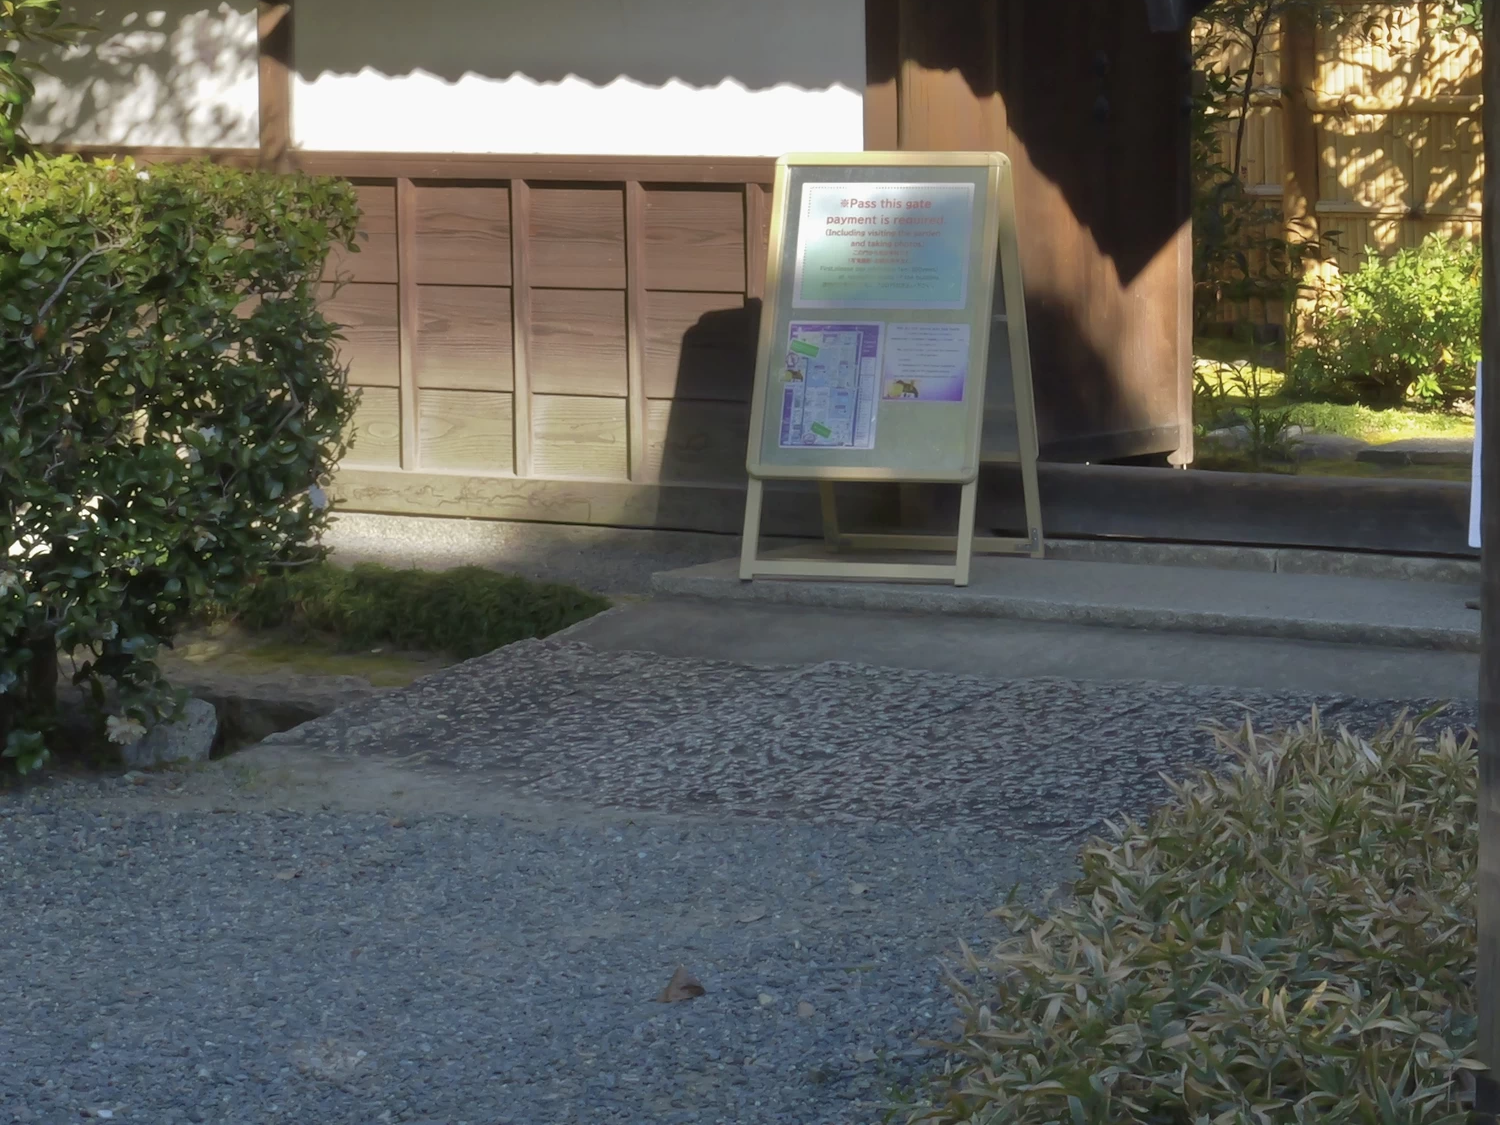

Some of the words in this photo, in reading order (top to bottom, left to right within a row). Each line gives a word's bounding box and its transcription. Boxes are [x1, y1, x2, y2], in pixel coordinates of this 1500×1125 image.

[880, 198, 902, 209] this
[906, 199, 932, 211] gate
[826, 215, 877, 226] payment
[880, 215, 890, 225] is
[867, 229, 896, 237] visiting
[868, 240, 892, 249] taking
